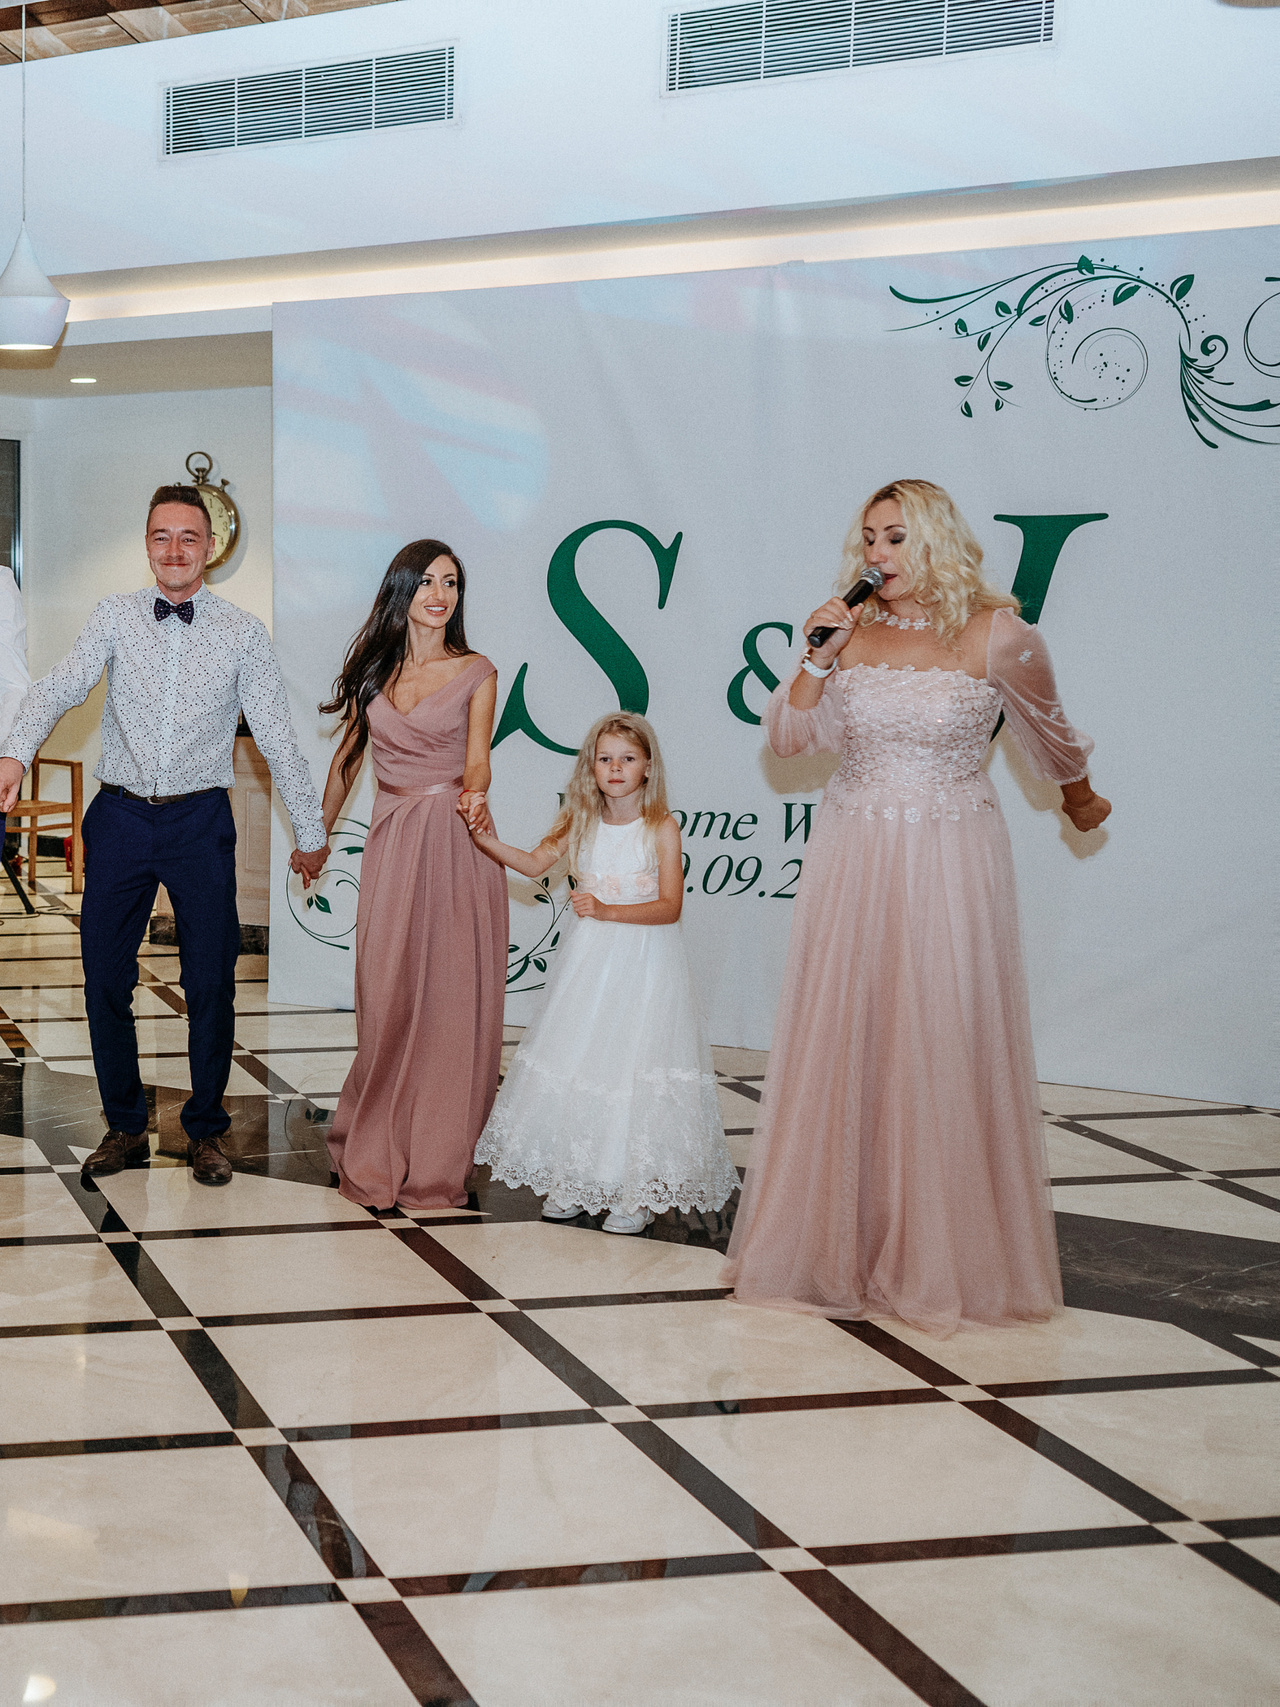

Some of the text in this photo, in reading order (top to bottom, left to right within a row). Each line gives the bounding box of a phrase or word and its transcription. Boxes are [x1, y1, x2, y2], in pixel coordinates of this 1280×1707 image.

[491, 519, 683, 757] S
[726, 621, 794, 726] &
[681, 852, 803, 899] .09.2
